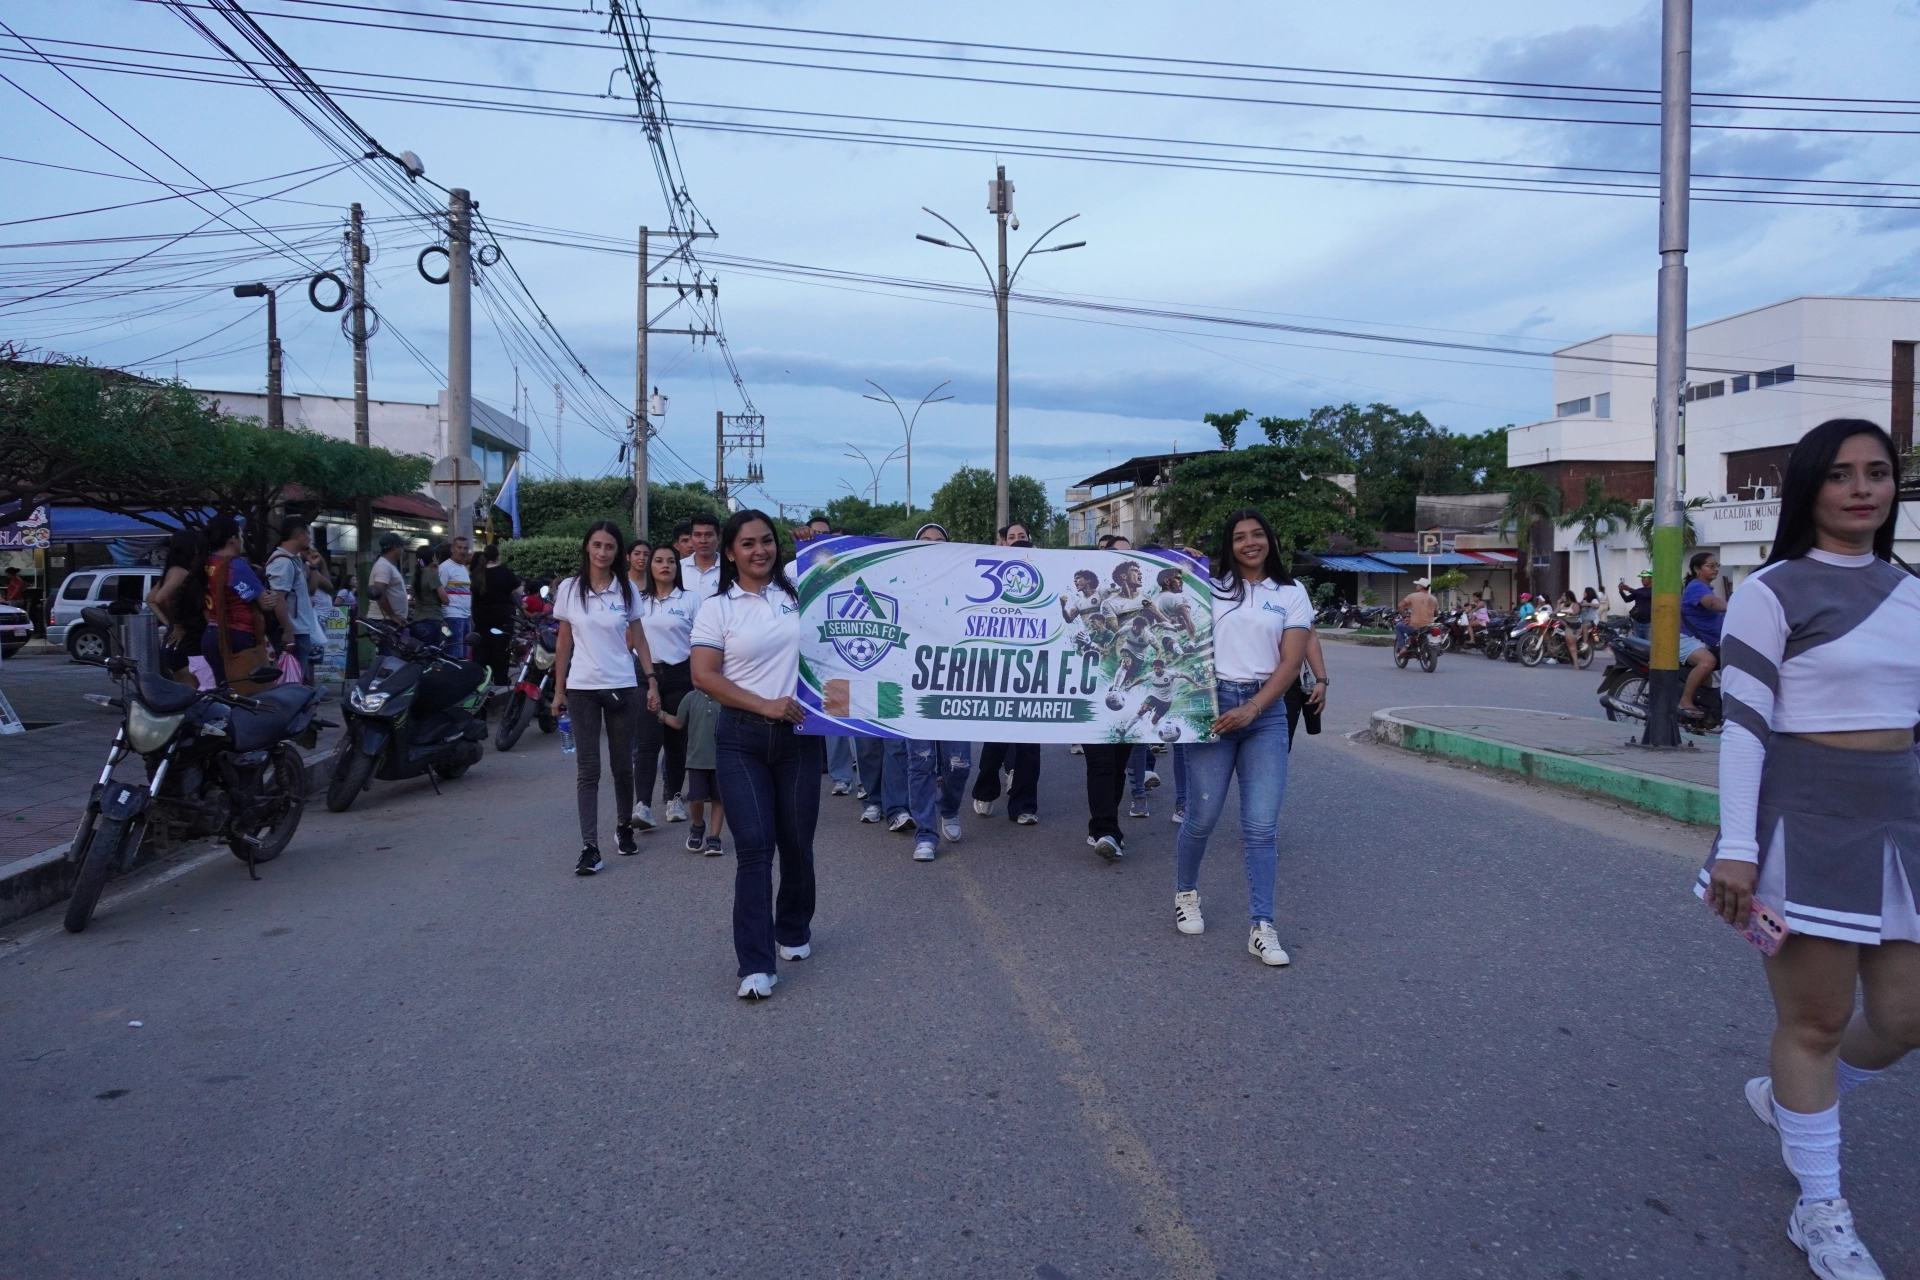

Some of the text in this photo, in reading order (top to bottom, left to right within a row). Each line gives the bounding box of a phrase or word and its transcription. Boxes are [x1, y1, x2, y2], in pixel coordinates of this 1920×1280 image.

[1713, 507, 1752, 520] ALCALDIA
[1743, 520, 1763, 531] TIBU
[965, 558, 1042, 604] 30
[990, 606, 1023, 615] COPA
[828, 621, 897, 639] SERINTSA FC
[965, 614, 1047, 639] SERINTSA
[911, 644, 1100, 695] SERINTSA F.C
[940, 698, 1075, 719] COSTA DE MARFIL
